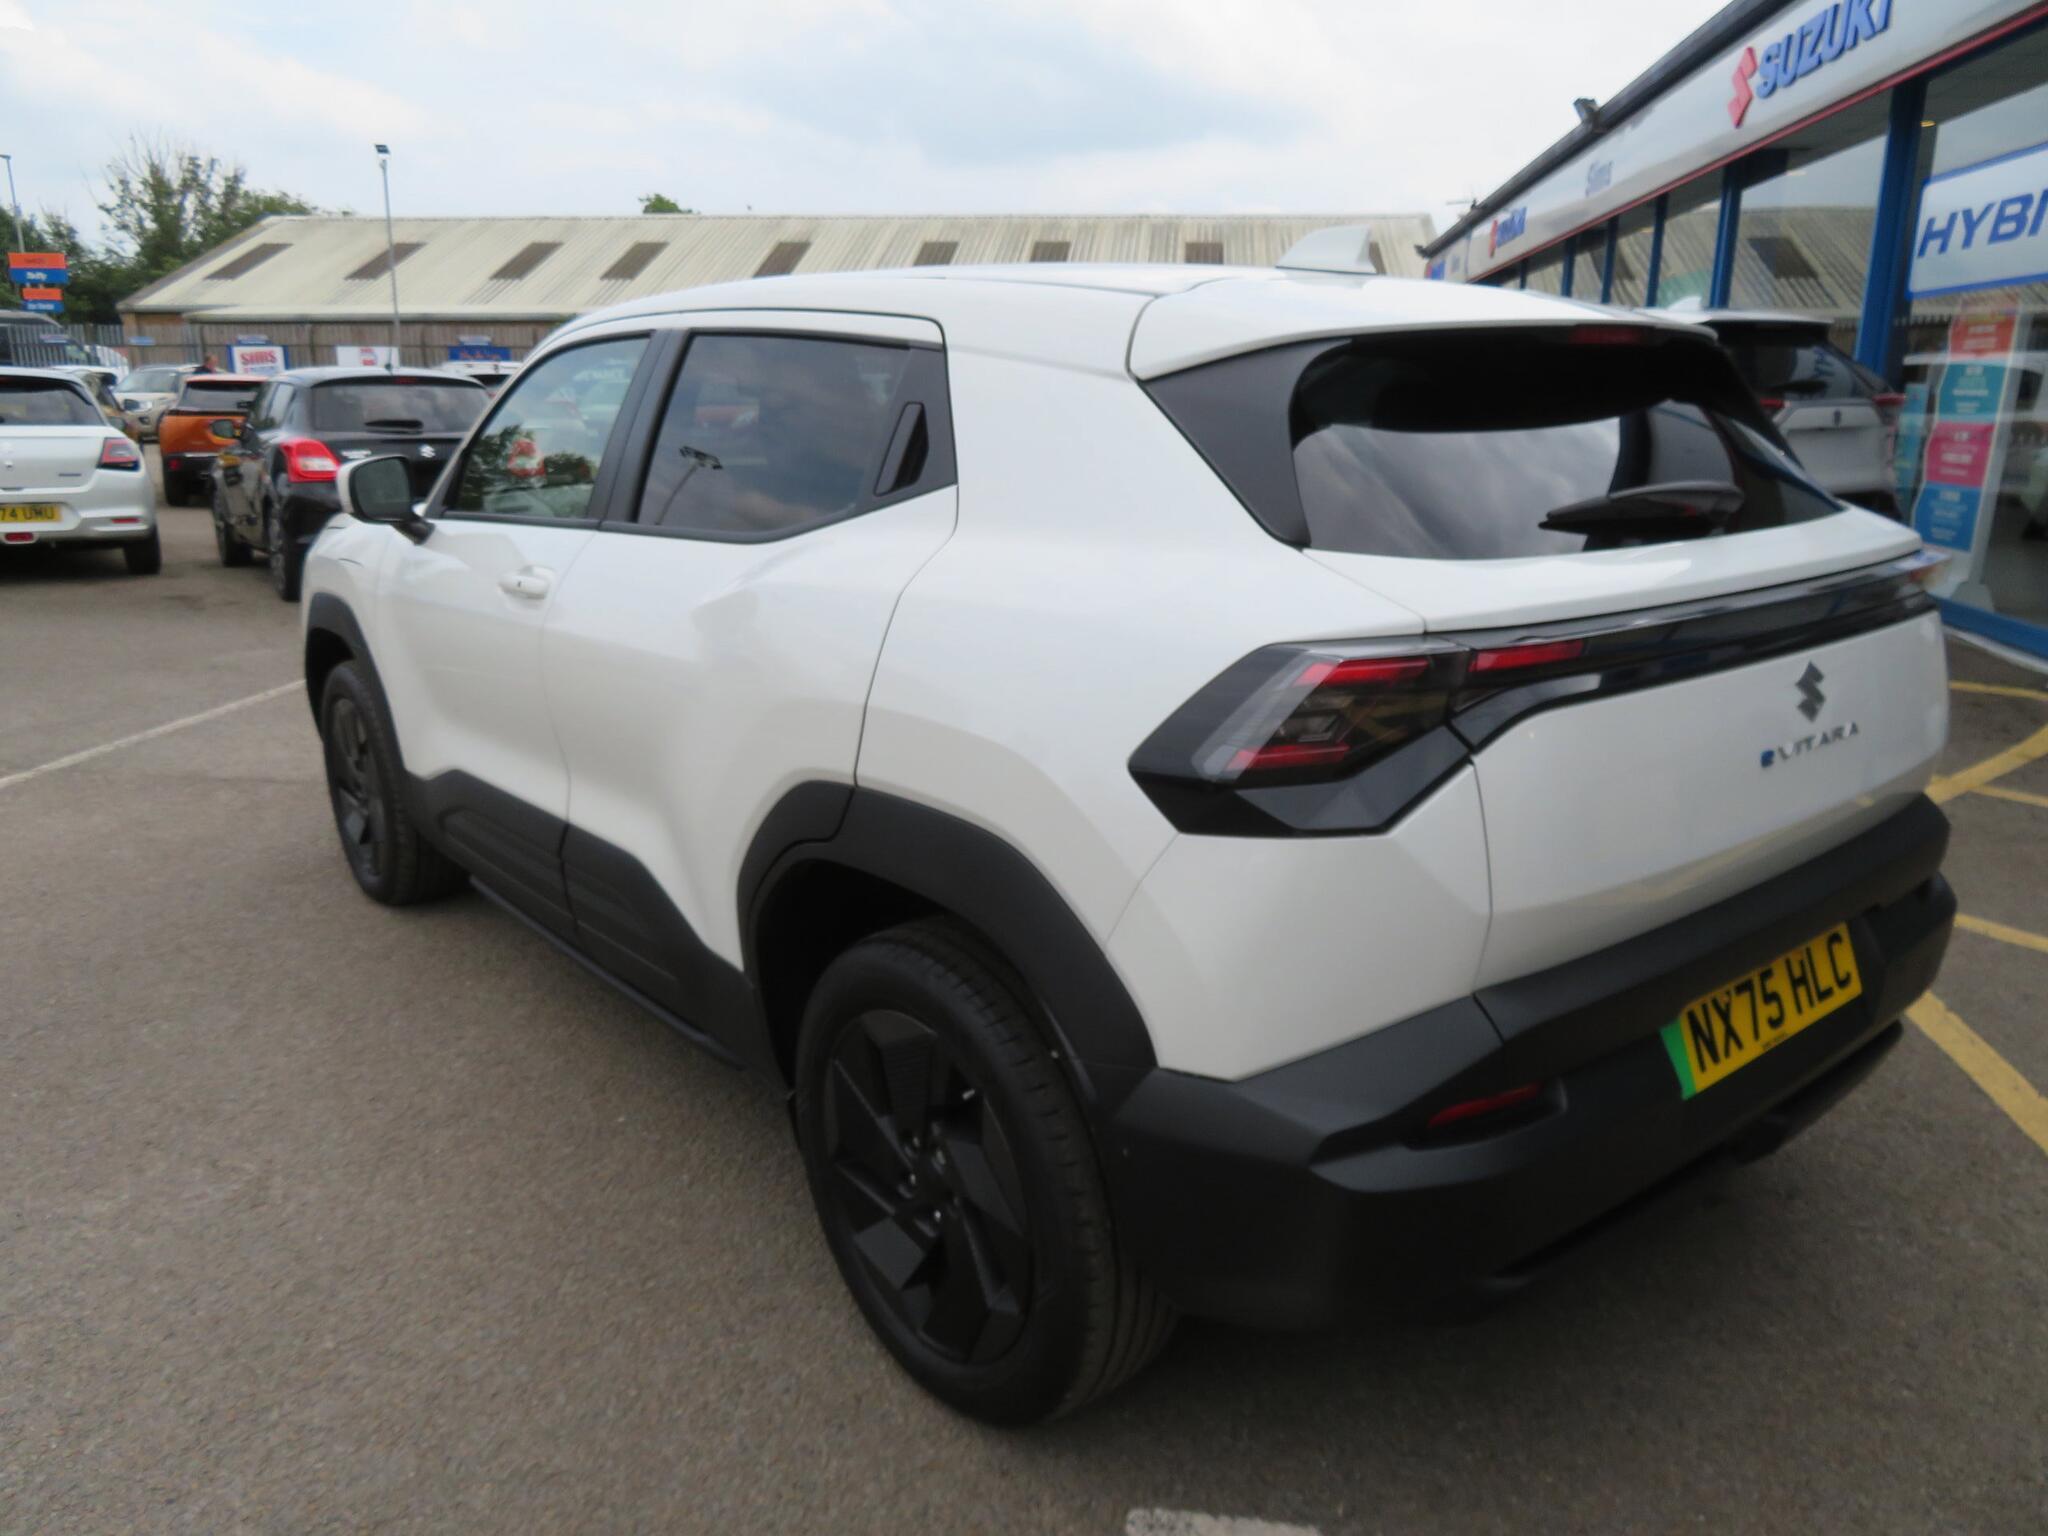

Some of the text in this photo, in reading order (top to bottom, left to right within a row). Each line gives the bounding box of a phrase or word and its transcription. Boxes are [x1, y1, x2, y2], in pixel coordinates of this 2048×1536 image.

[1755, 0, 1894, 99] SUZUKI
[1686, 932, 1852, 1073] NX75 HLC
